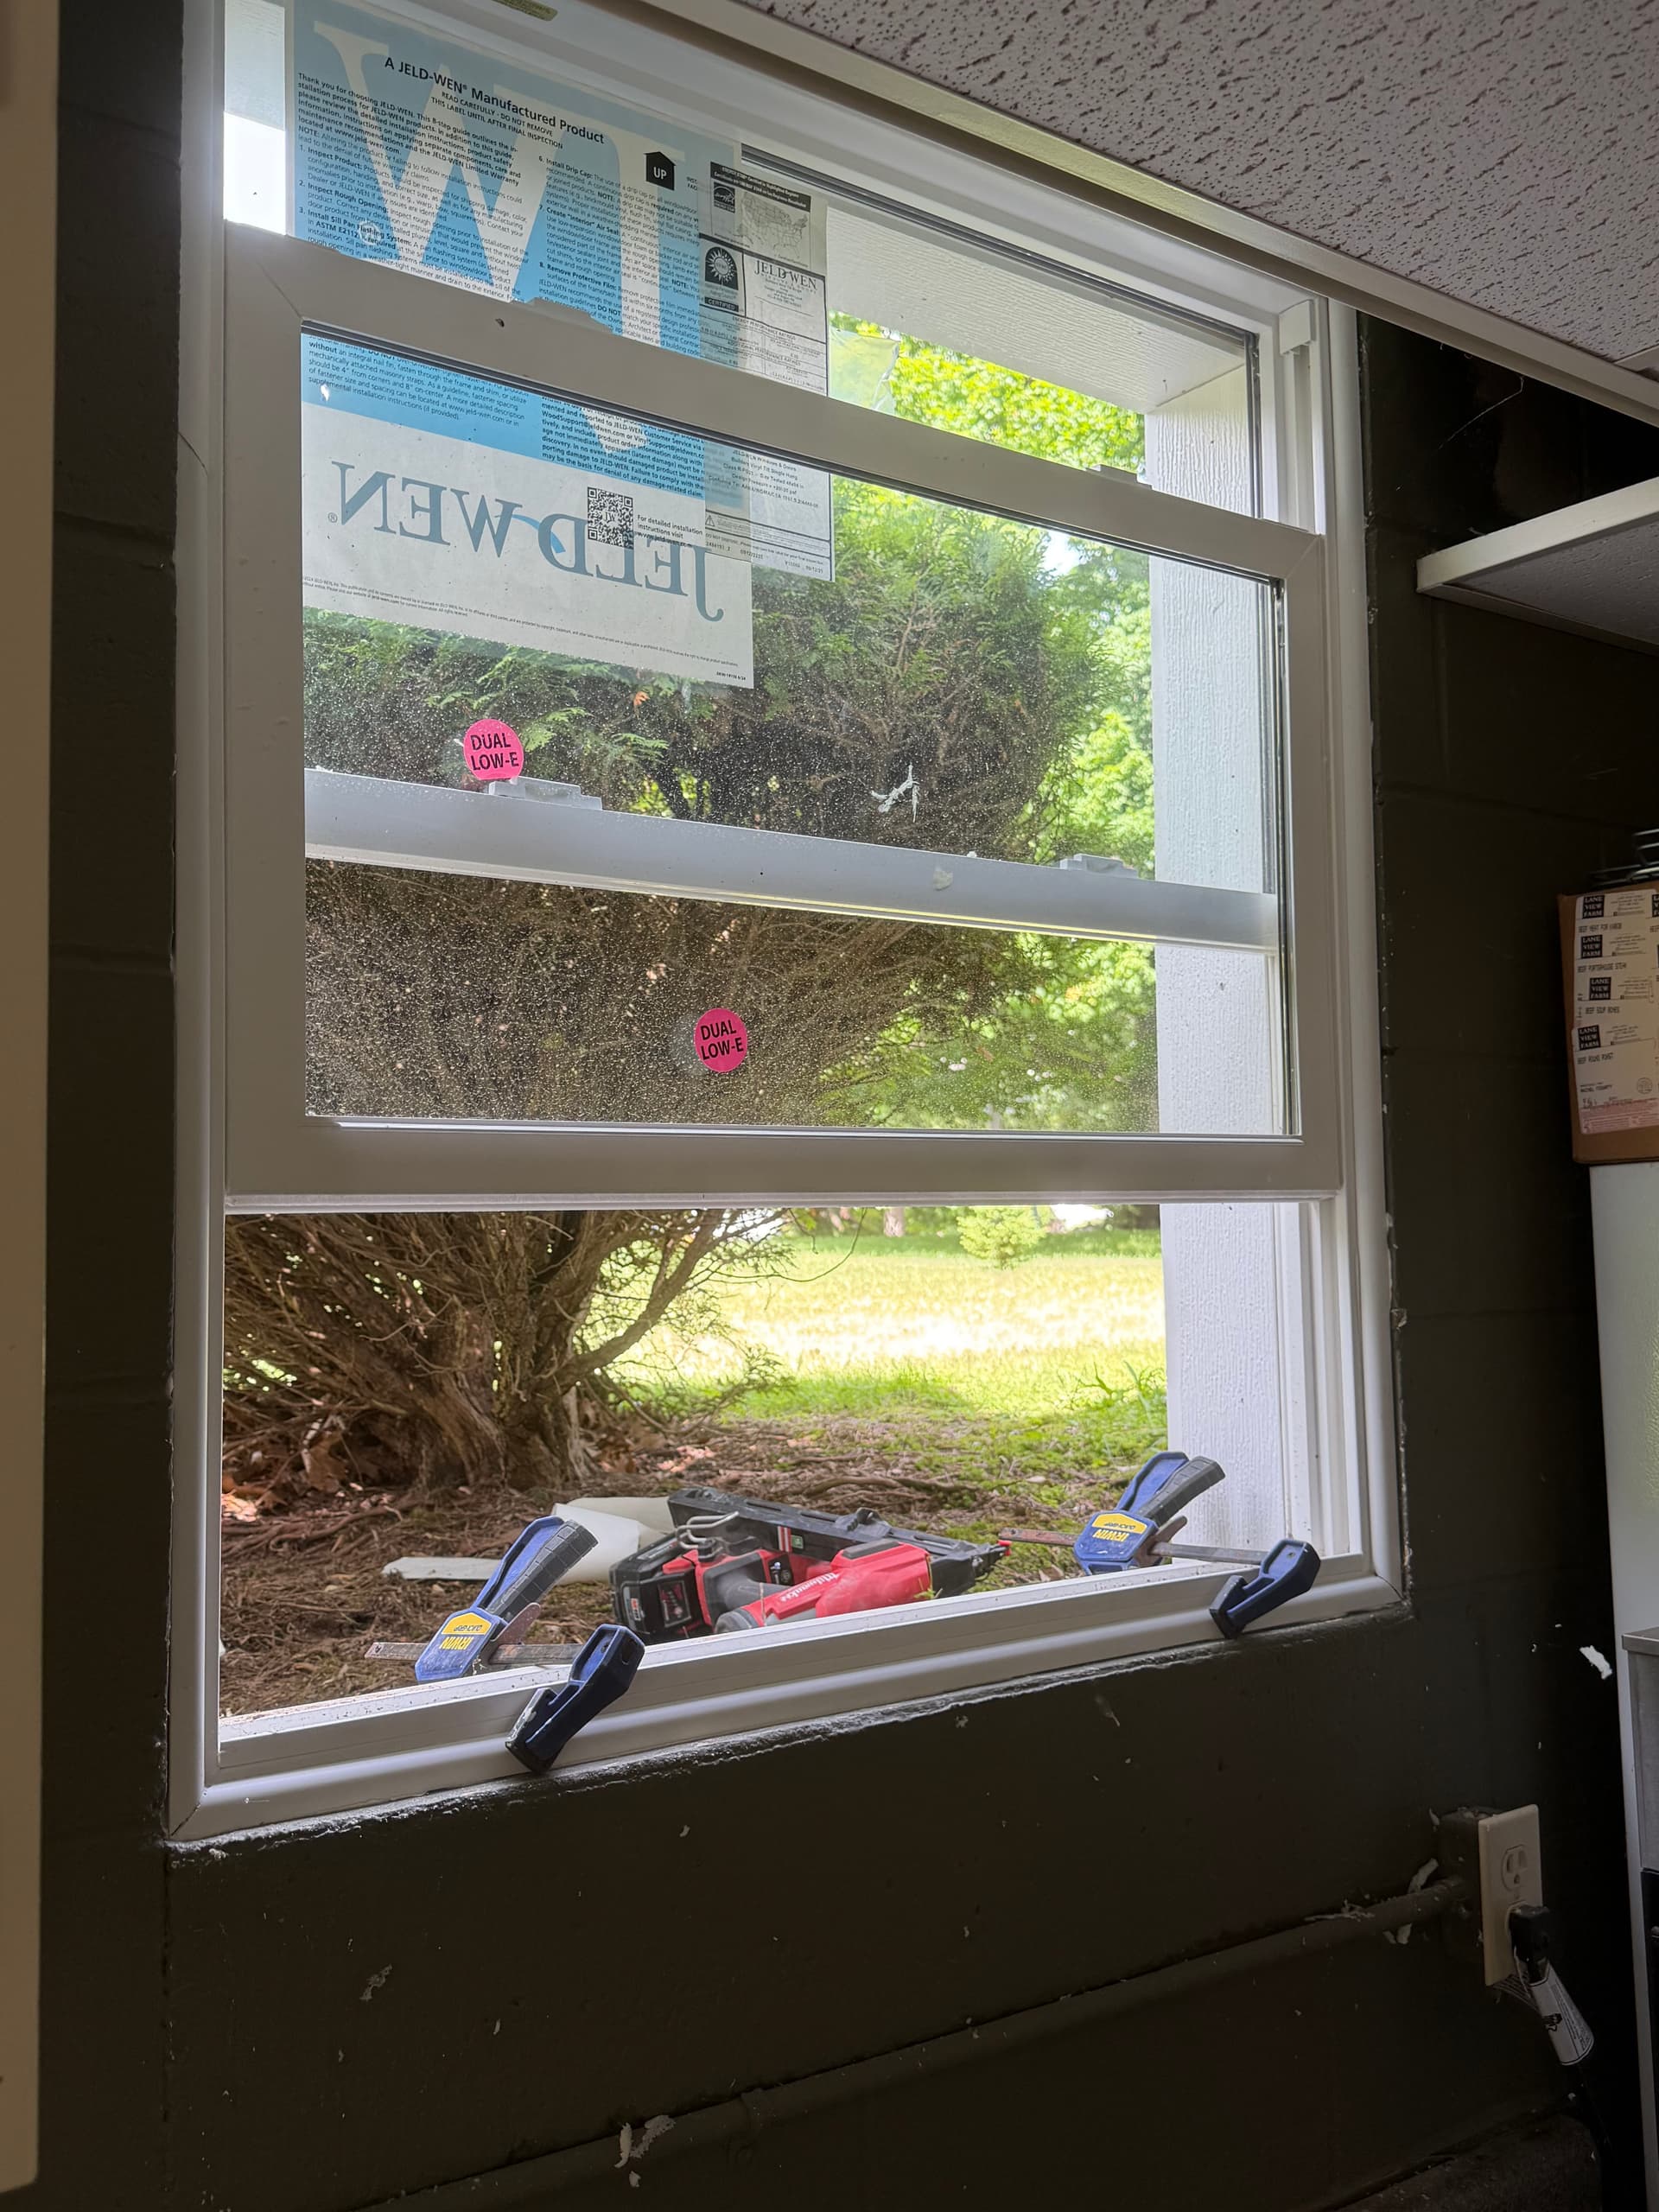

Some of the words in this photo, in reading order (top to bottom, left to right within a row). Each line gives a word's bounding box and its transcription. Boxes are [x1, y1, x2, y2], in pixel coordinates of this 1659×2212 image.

[298, 73, 320, 86] Thank
[321, 81, 334, 91] you
[335, 85, 346, 95] for
[347, 90, 378, 107] choosing
[379, 100, 415, 118] JELD-WEN.
[416, 112, 430, 124] This
[452, 125, 470, 137] guide
[472, 132, 497, 146] outlines
[499, 140, 508, 149] the
[385, 56, 394, 70] A
[471, 87, 555, 127] Manufactured
[560, 118, 603, 144] Product
[442, 91, 458, 103] READ
[460, 98, 494, 116] CAREFULLY
[500, 112, 510, 121] DO
[512, 117, 524, 127] NOT
[526, 122, 552, 137] REMOVE
[297, 82, 330, 98] stallation
[332, 93, 357, 107] process
[359, 101, 369, 111] for
[371, 105, 404, 123] JELD-WEN
[405, 118, 435, 134] products.
[437, 128, 443, 137] In
[445, 132, 471, 146] addition
[473, 140, 480, 149] to
[481, 143, 493, 153] this
[494, 149, 513, 162] guide,
[297, 114, 323, 129] located
[334, 127, 401, 155] www.jeld-wen.com.
[298, 91, 320, 103] please
[321, 99, 346, 111] review
[347, 106, 358, 116] the
[359, 110, 386, 125] detailed
[389, 120, 425, 138] installation
[427, 132, 465, 153] instructions,
[467, 148, 492, 161] product
[493, 156, 512, 168] safety
[430, 97, 445, 108] THIS
[446, 102, 466, 115] LABEL
[467, 110, 486, 122] UNTIL
[487, 117, 506, 130] AFTER
[508, 124, 525, 136] FINAL
[527, 130, 563, 149] INSPECTION
[297, 107, 343, 127] maintenance
[345, 123, 404, 148] recommendations
[405, 143, 417, 152] and
[419, 146, 429, 156] the
[431, 150, 464, 168] JELD-WEN
[466, 162, 488, 175] Limited
[490, 170, 518, 188] Warranty
[298, 98, 340, 119] information,
[343, 113, 382, 132] instructions
[394, 131, 423, 147] applying
[424, 142, 451, 156] separate
[453, 151, 493, 170] components,
[494, 165, 507, 174] care
[509, 169, 520, 179] and
[308, 147, 332, 161] Inspect
[334, 155, 362, 169] Product:
[363, 163, 390, 178] Products
[546, 158, 564, 169] Install
[565, 164, 578, 175] Drip
[579, 168, 593, 180] Cap:
[654, 166, 667, 180] UP
[308, 181, 333, 195] Inspect
[334, 190, 356, 203] Rough
[358, 197, 388, 214] Opening:
[308, 208, 328, 221] Install
[331, 215, 341, 225] Sill
[343, 219, 354, 229] Pan
[385, 232, 412, 246] System:
[546, 207, 566, 219] Create
[595, 222, 605, 231] Air
[606, 226, 620, 236] Seal:
[547, 263, 570, 276] Remove
[572, 270, 601, 286] Protective
[602, 280, 616, 290] Film:
[542, 403, 564, 413] mented
[579, 413, 604, 424] reported
[613, 421, 642, 435] JELD-WEN
[644, 429, 671, 442] Customer
[671, 436, 691, 448] Service
[542, 453, 555, 462] may
[577, 461, 592, 470] basis
[603, 467, 621, 477] denial
[642, 477, 686, 493] damage-related
[687, 489, 702, 498] claim.
[637, 522, 670, 535] instructions
[647, 517, 671, 527] detailed
[671, 522, 702, 535] installation
[470, 733, 512, 750] DUAL
[471, 752, 519, 772] LOW-E
[701, 1020, 736, 1040] DUAL
[700, 1037, 743, 1060] LOW-E
[1092, 1529, 1130, 1542] IRWIN
[439, 1637, 474, 1650] IRWIN
